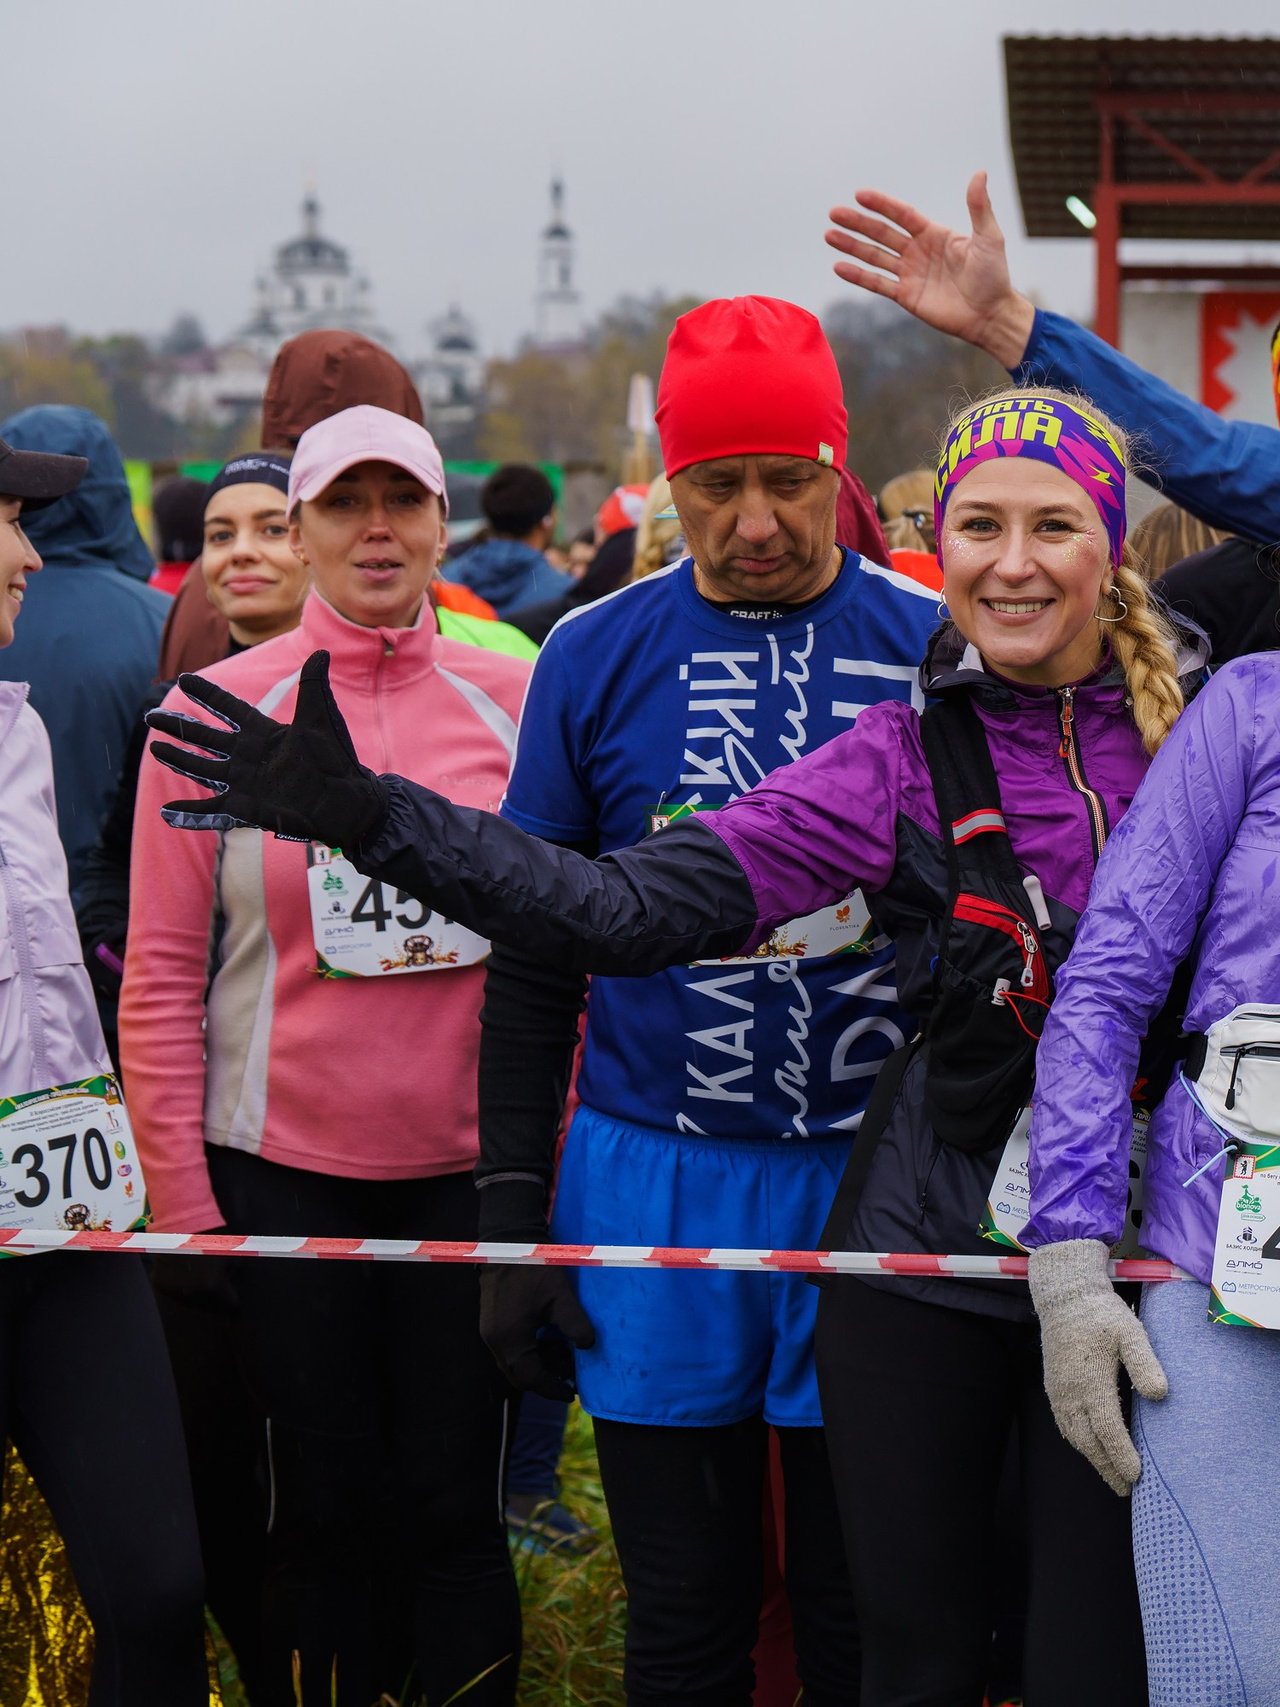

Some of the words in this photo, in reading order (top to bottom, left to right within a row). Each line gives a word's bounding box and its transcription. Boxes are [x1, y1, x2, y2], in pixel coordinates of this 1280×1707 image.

[934, 411, 1063, 502] СИЛА
[730, 609, 771, 620] CRAFT
[350, 878, 454, 933] 45
[11, 1127, 112, 1208] 370
[1236, 1202, 1262, 1211] bionova
[1226, 1243, 1243, 1251] БАЗИС
[1238, 1283, 1280, 1293] МЕТРОСТРОЙ
